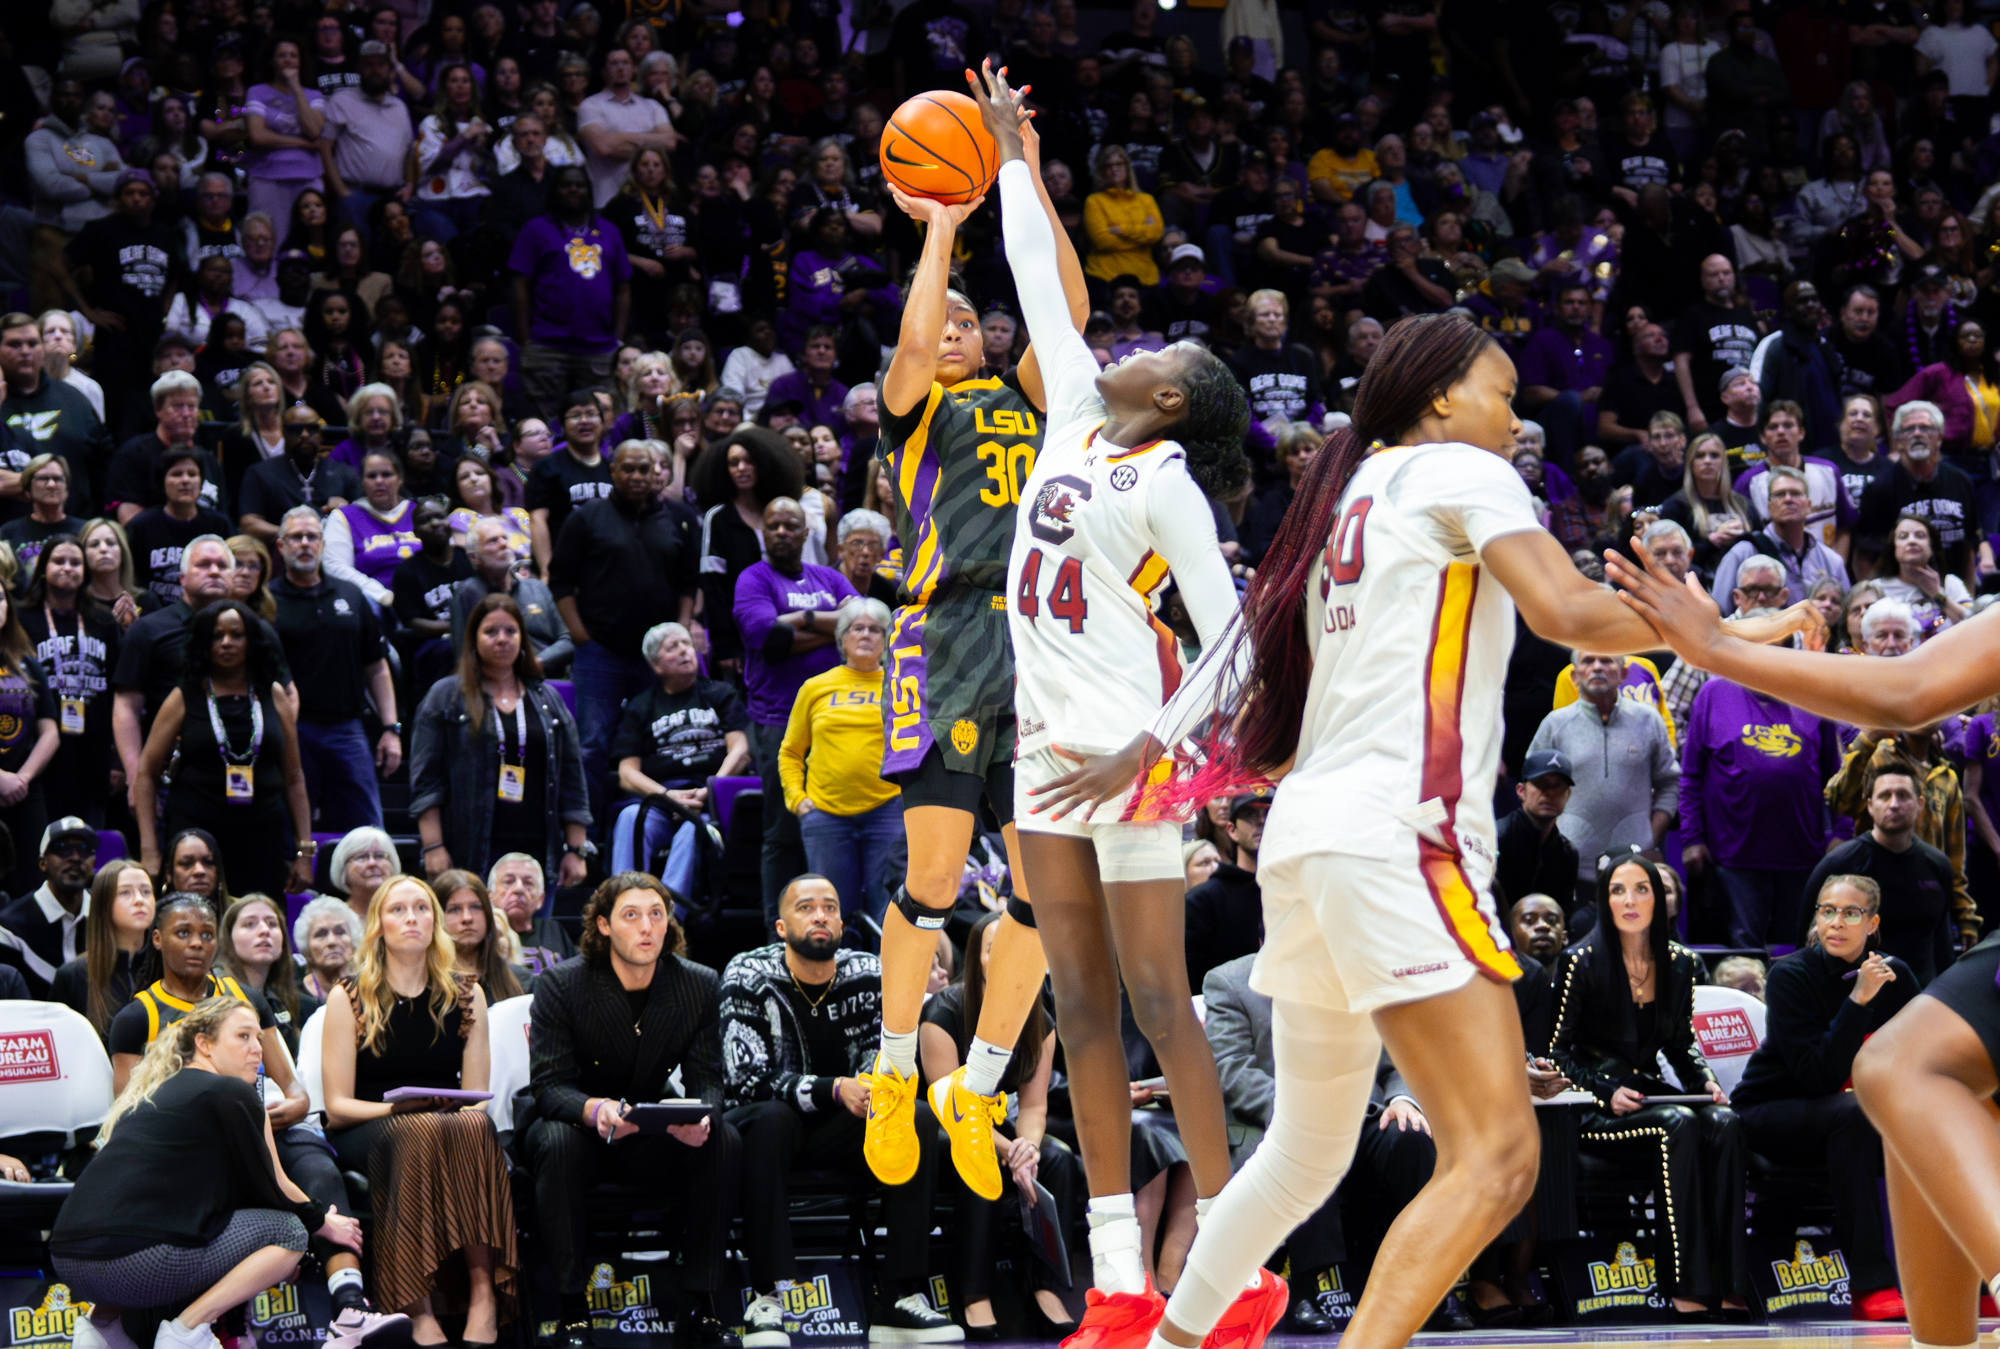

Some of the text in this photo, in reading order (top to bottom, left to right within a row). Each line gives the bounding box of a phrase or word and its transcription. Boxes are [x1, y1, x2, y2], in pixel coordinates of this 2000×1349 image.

[975, 408, 1037, 436] LSU
[976, 441, 1035, 508] 30
[1018, 547, 1088, 634] 44
[1325, 603, 1356, 634] UDA
[890, 645, 922, 752] LSU
[521, 946, 565, 976] SU
[1391, 961, 1450, 978] GAMECOCKS
[1698, 1024, 1748, 1042] BUREAU
[1706, 1013, 1744, 1029] FARM
[0, 1036, 46, 1052] FARM
[1712, 1039, 1753, 1053] INSURANCE
[1593, 1262, 1656, 1291] Beng
[1776, 1252, 1846, 1289] Bengal
[254, 1284, 295, 1322] gal
[592, 1278, 647, 1311] ngal
[1323, 1291, 1352, 1306] .com
[15, 1307, 81, 1339] Beng
[275, 1314, 307, 1330] .com
[802, 1321, 864, 1336] G.O.N.E.
[810, 1308, 841, 1323] .com
